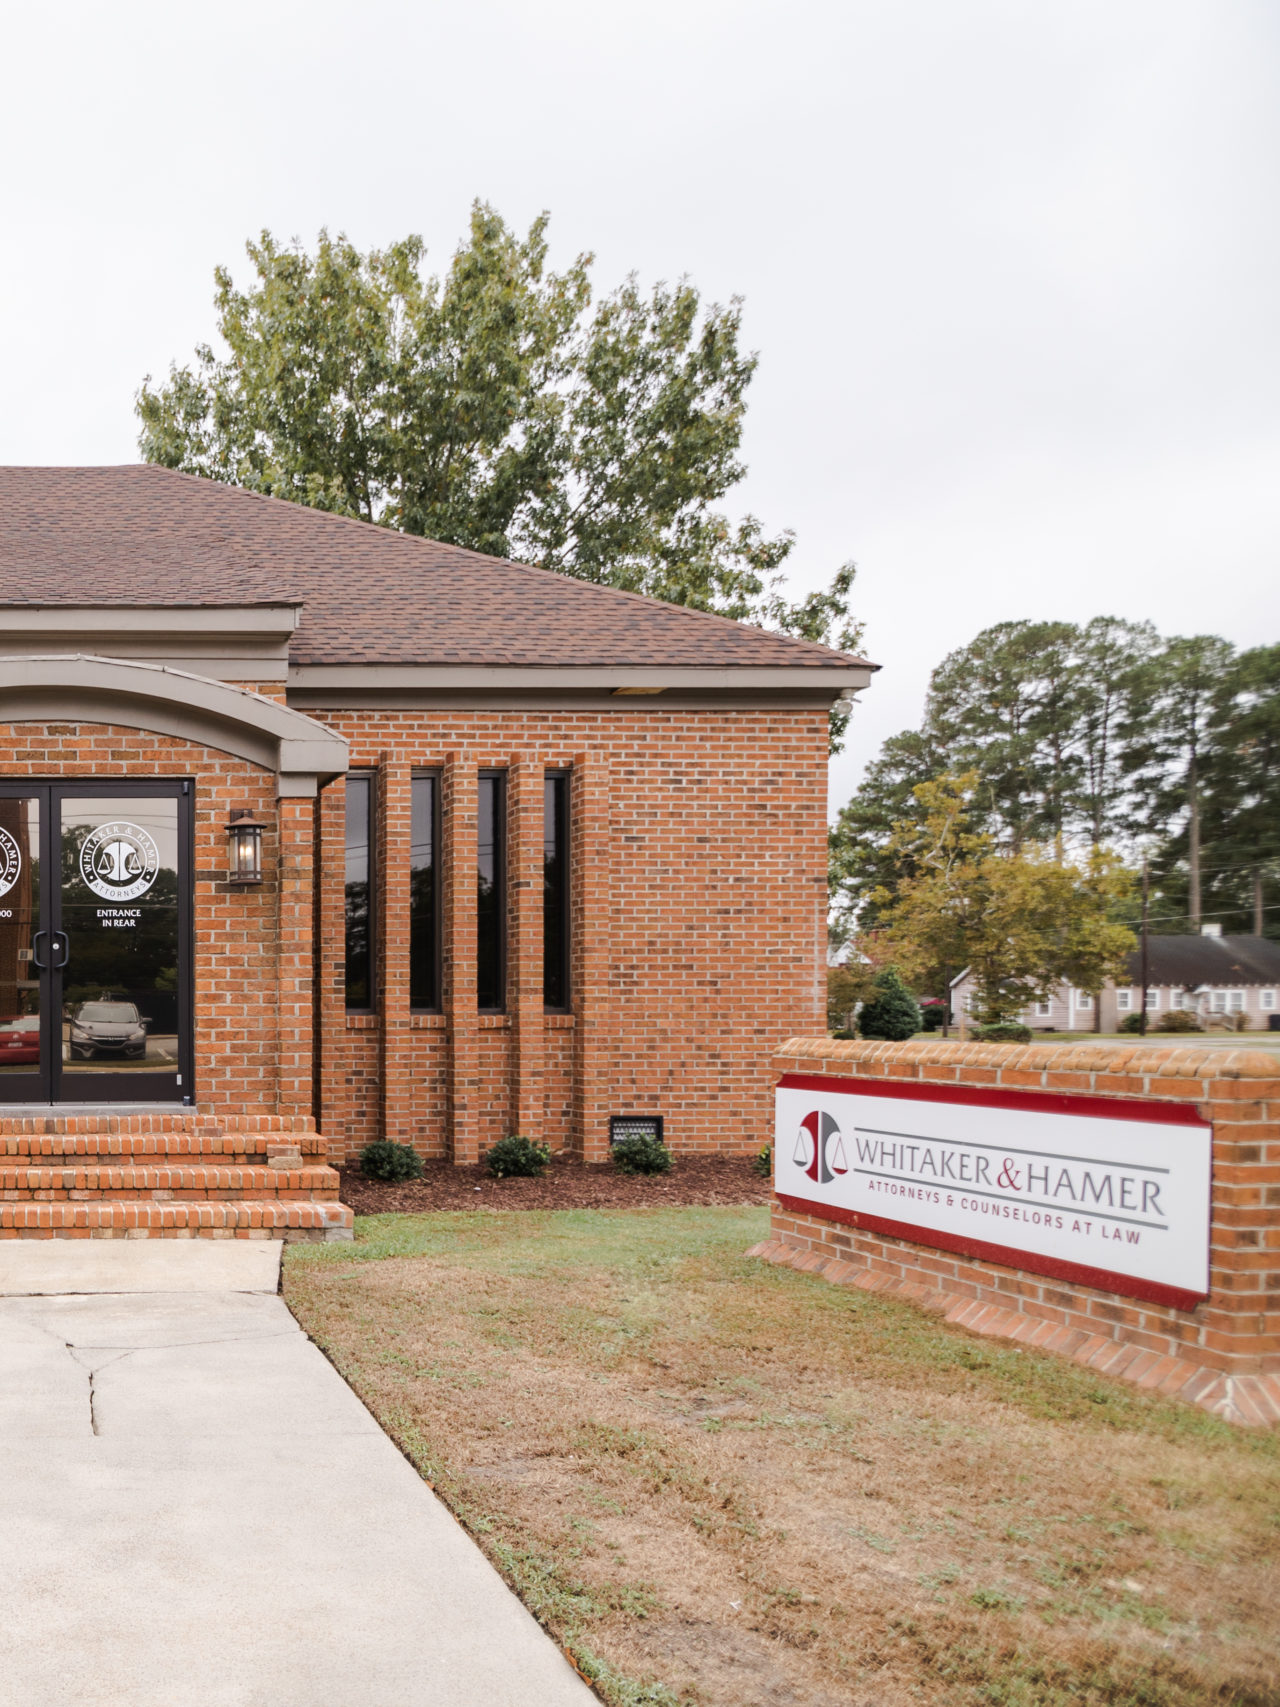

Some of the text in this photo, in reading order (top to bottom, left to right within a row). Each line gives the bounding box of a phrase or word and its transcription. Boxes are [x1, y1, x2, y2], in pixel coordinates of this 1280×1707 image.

[83, 826, 155, 874] WHITAKER & HAMER
[92, 881, 146, 897] ATTORNEYS
[96, 909, 141, 917] ENTRANCE
[102, 919, 136, 927] IN REAR
[868, 1180, 1141, 1245] ATTORNEYS & COUNSELORS AT LAW
